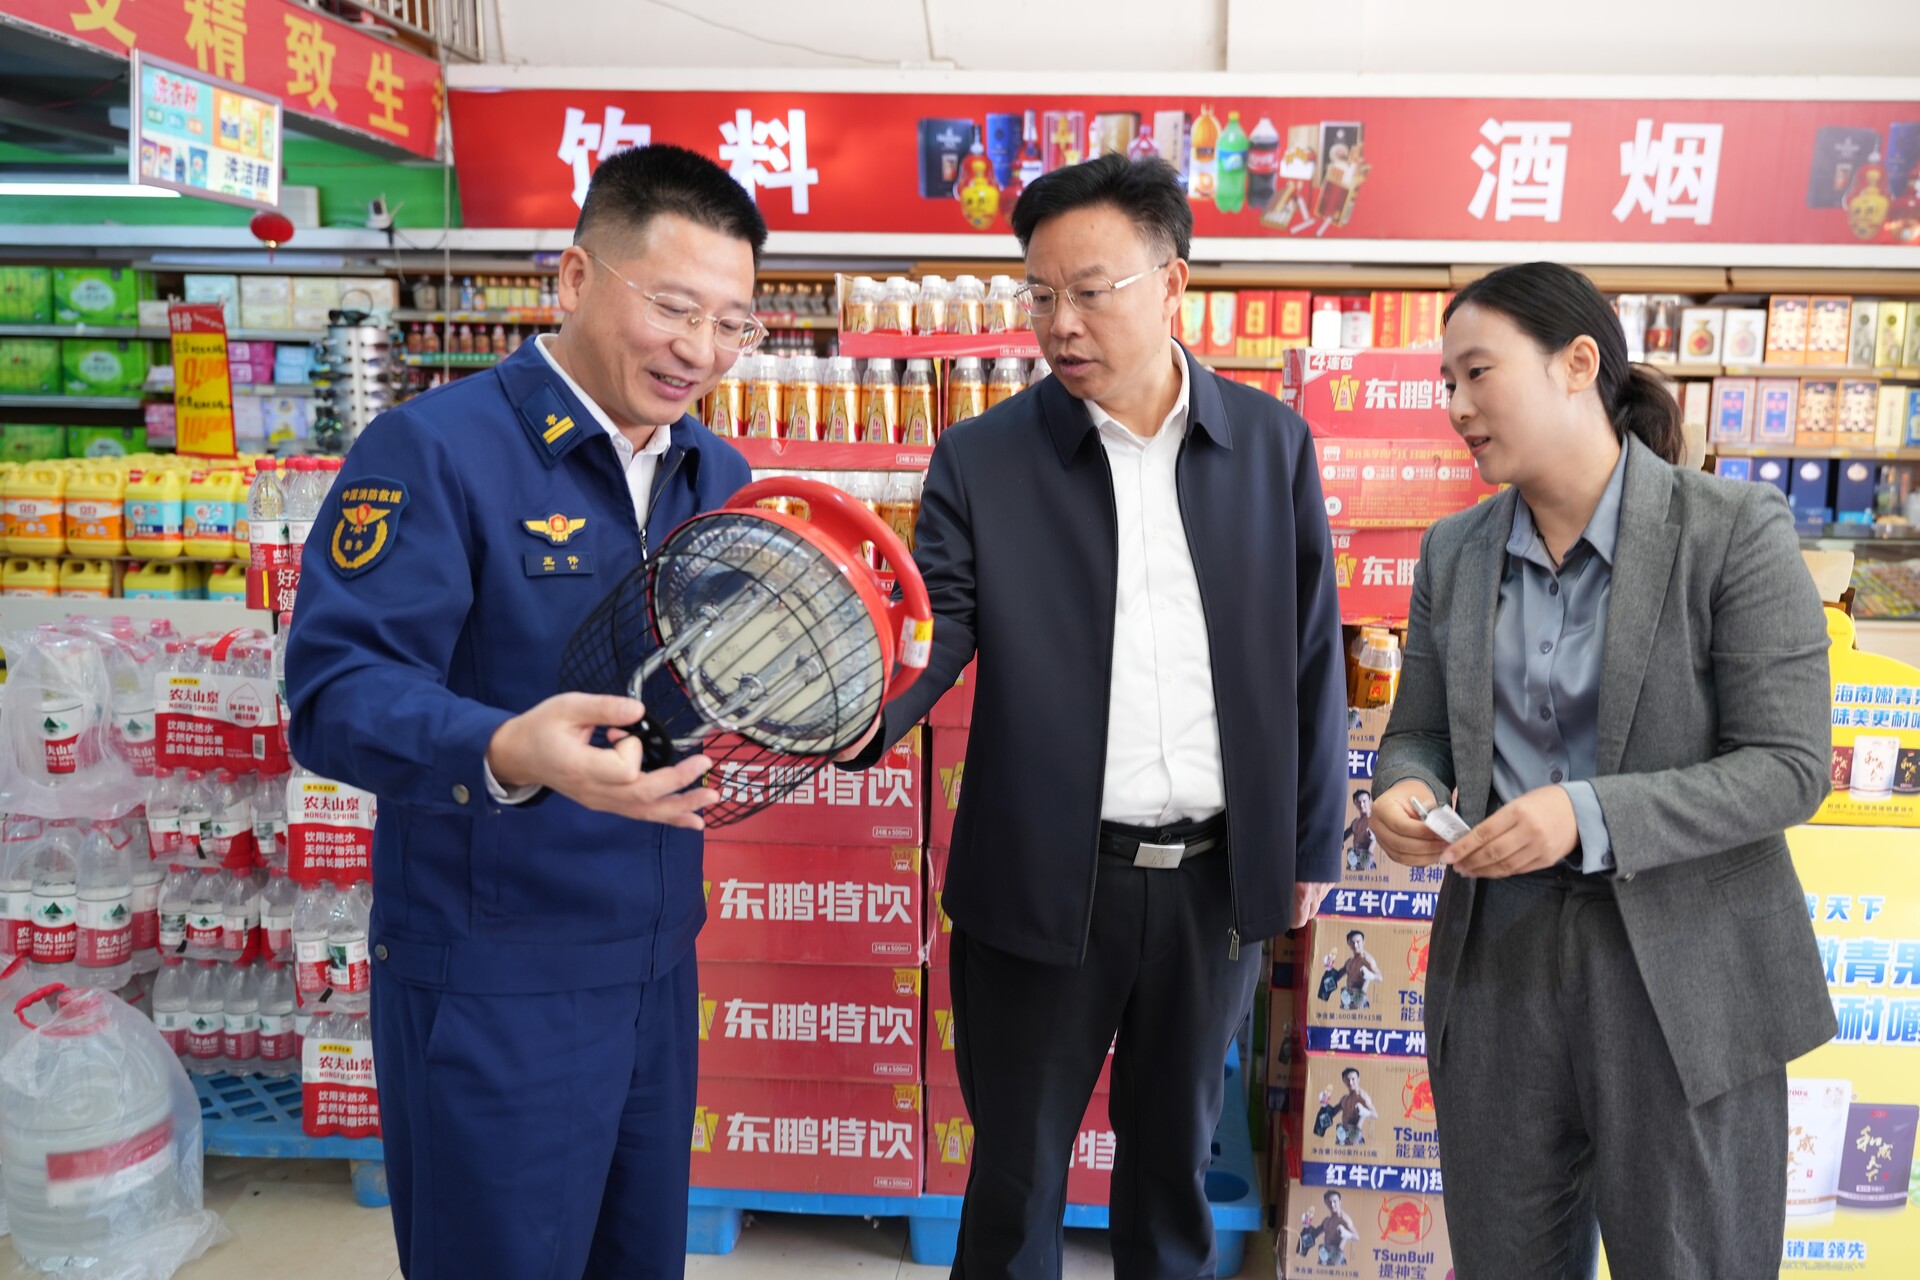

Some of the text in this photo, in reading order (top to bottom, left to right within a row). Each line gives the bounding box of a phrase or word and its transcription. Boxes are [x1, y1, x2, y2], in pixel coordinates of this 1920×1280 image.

[224, 155, 270, 189] 洗洁精
[277, 568, 301, 588] 好
[169, 688, 219, 704] 农夫山泉
[167, 720, 214, 733] 饮用天然水
[166, 732, 223, 745] 天然矿物元素
[165, 743, 224, 757] 适合长期饮用
[719, 761, 913, 808] 东鹏特饮
[304, 795, 359, 811] 农夫山泉
[304, 811, 360, 820] NONGFU SPRING
[304, 831, 356, 844] 饮用天然水
[304, 843, 367, 856] 天然矿物元素
[303, 855, 368, 869] 适合长期饮用
[719, 878, 913, 924] 东鹏特饮
[97, 932, 132, 947] 农夫山
[724, 998, 913, 1046] 东鹏特饮
[319, 1056, 373, 1072] 农夫山泉
[318, 1090, 368, 1103] 饮用天然水
[317, 1102, 378, 1115] 天然矿物元素
[316, 1114, 379, 1128] 适合长期饮用
[726, 1112, 913, 1160] 东鹏特饮
[1068, 1129, 1116, 1171] 特
[1373, 1249, 1434, 1264] TSunBull
[1787, 1240, 1865, 1260] 销量领先
[1378, 1264, 1427, 1280] 提神宝
